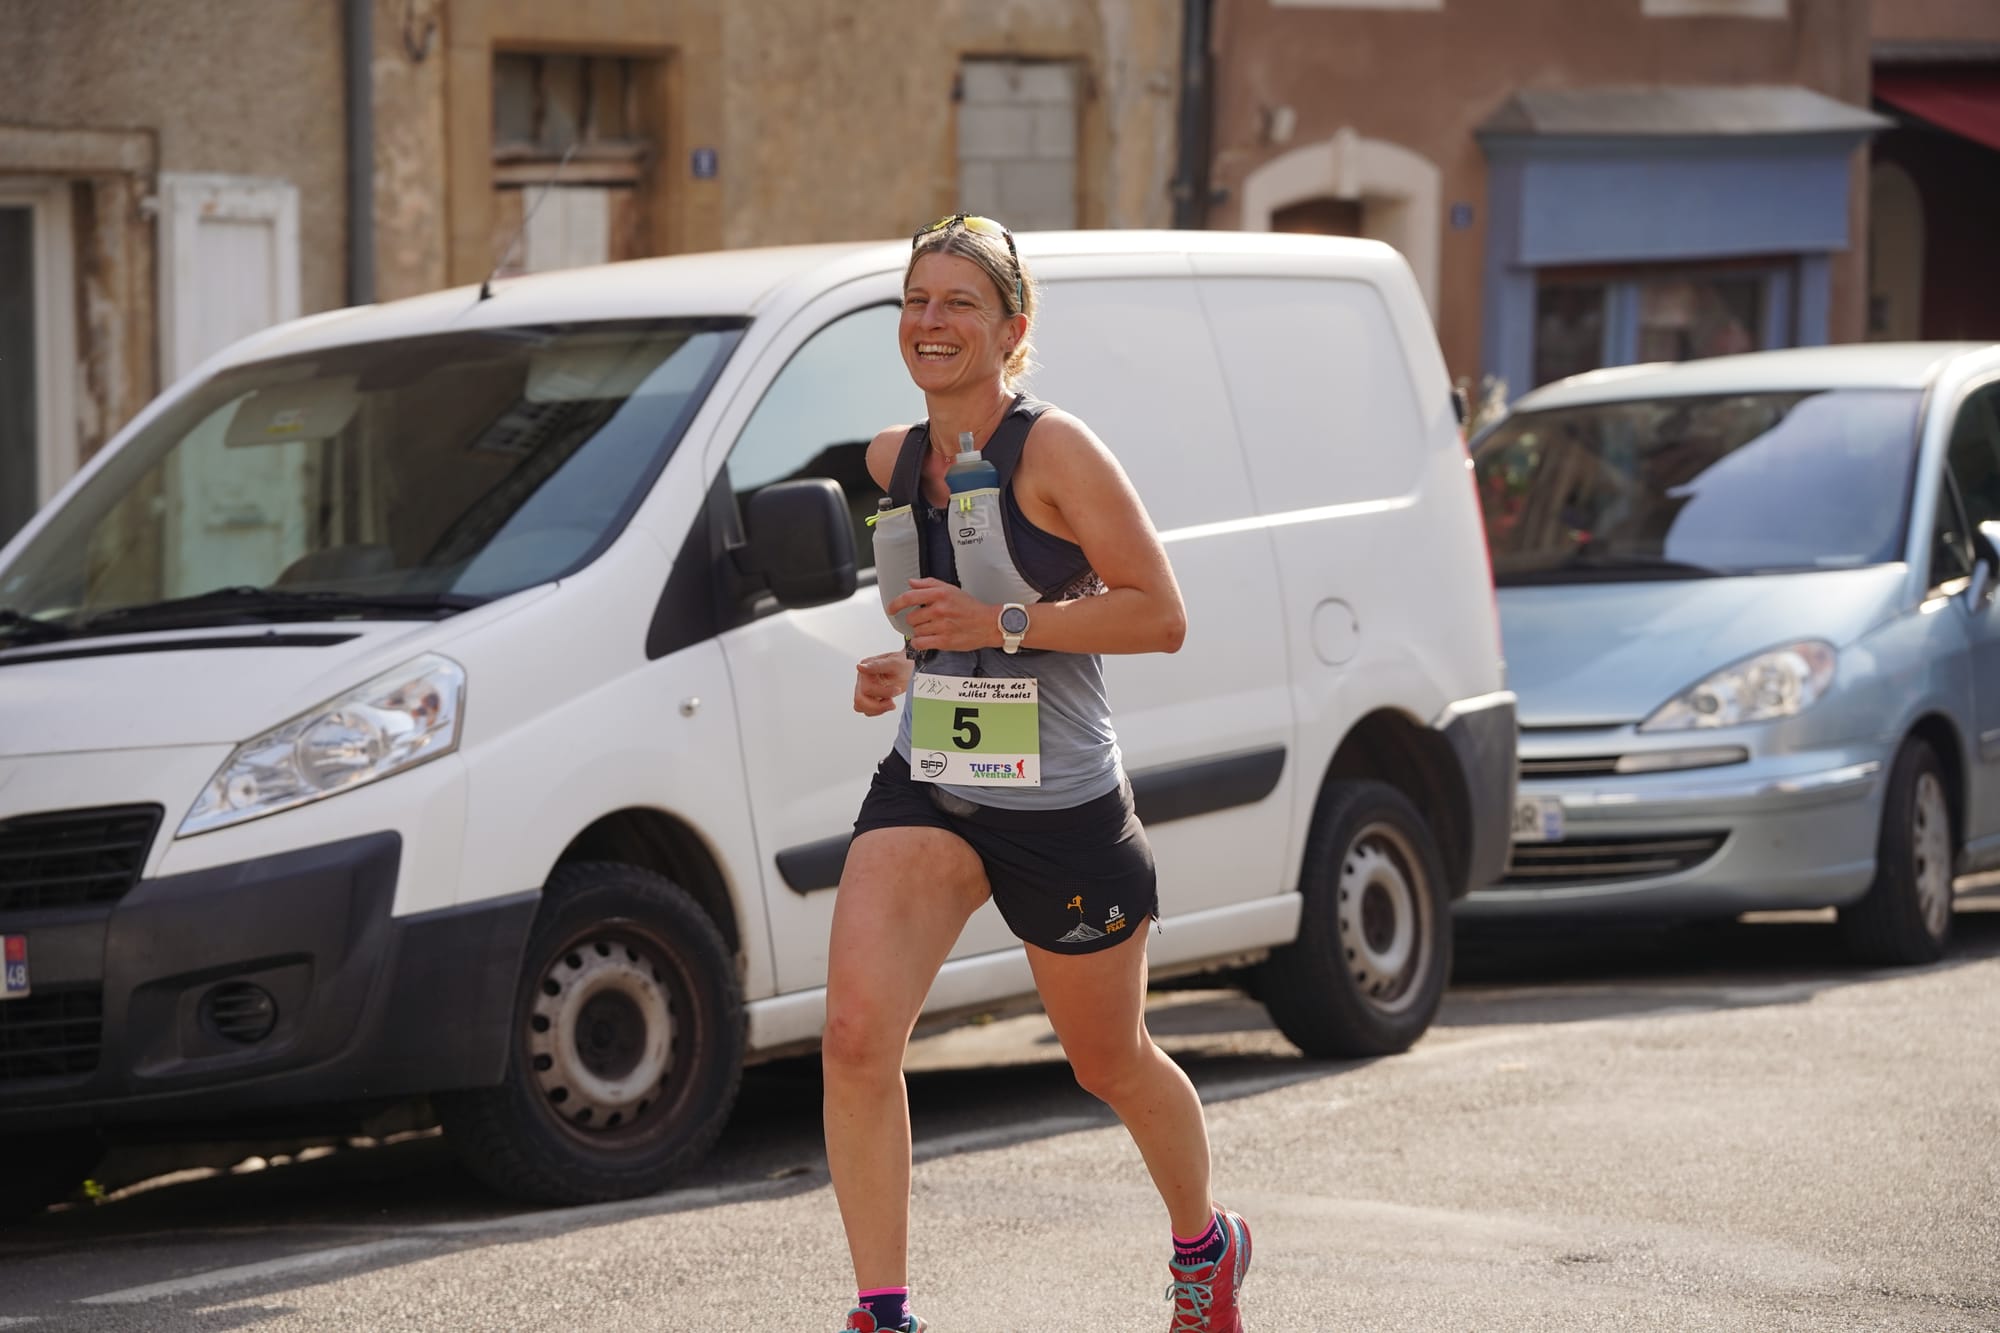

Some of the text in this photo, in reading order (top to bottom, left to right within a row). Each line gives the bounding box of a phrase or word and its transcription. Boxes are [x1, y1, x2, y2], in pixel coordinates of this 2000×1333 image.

[962, 681, 1026, 692] Challenge des
[958, 689, 1032, 699] vallées cévenoles
[952, 707, 981, 750] 5
[921, 760, 943, 770] BFP
[969, 763, 1012, 773] TUFF'S
[973, 770, 1017, 779] Aventure
[7, 964, 26, 987] 48
